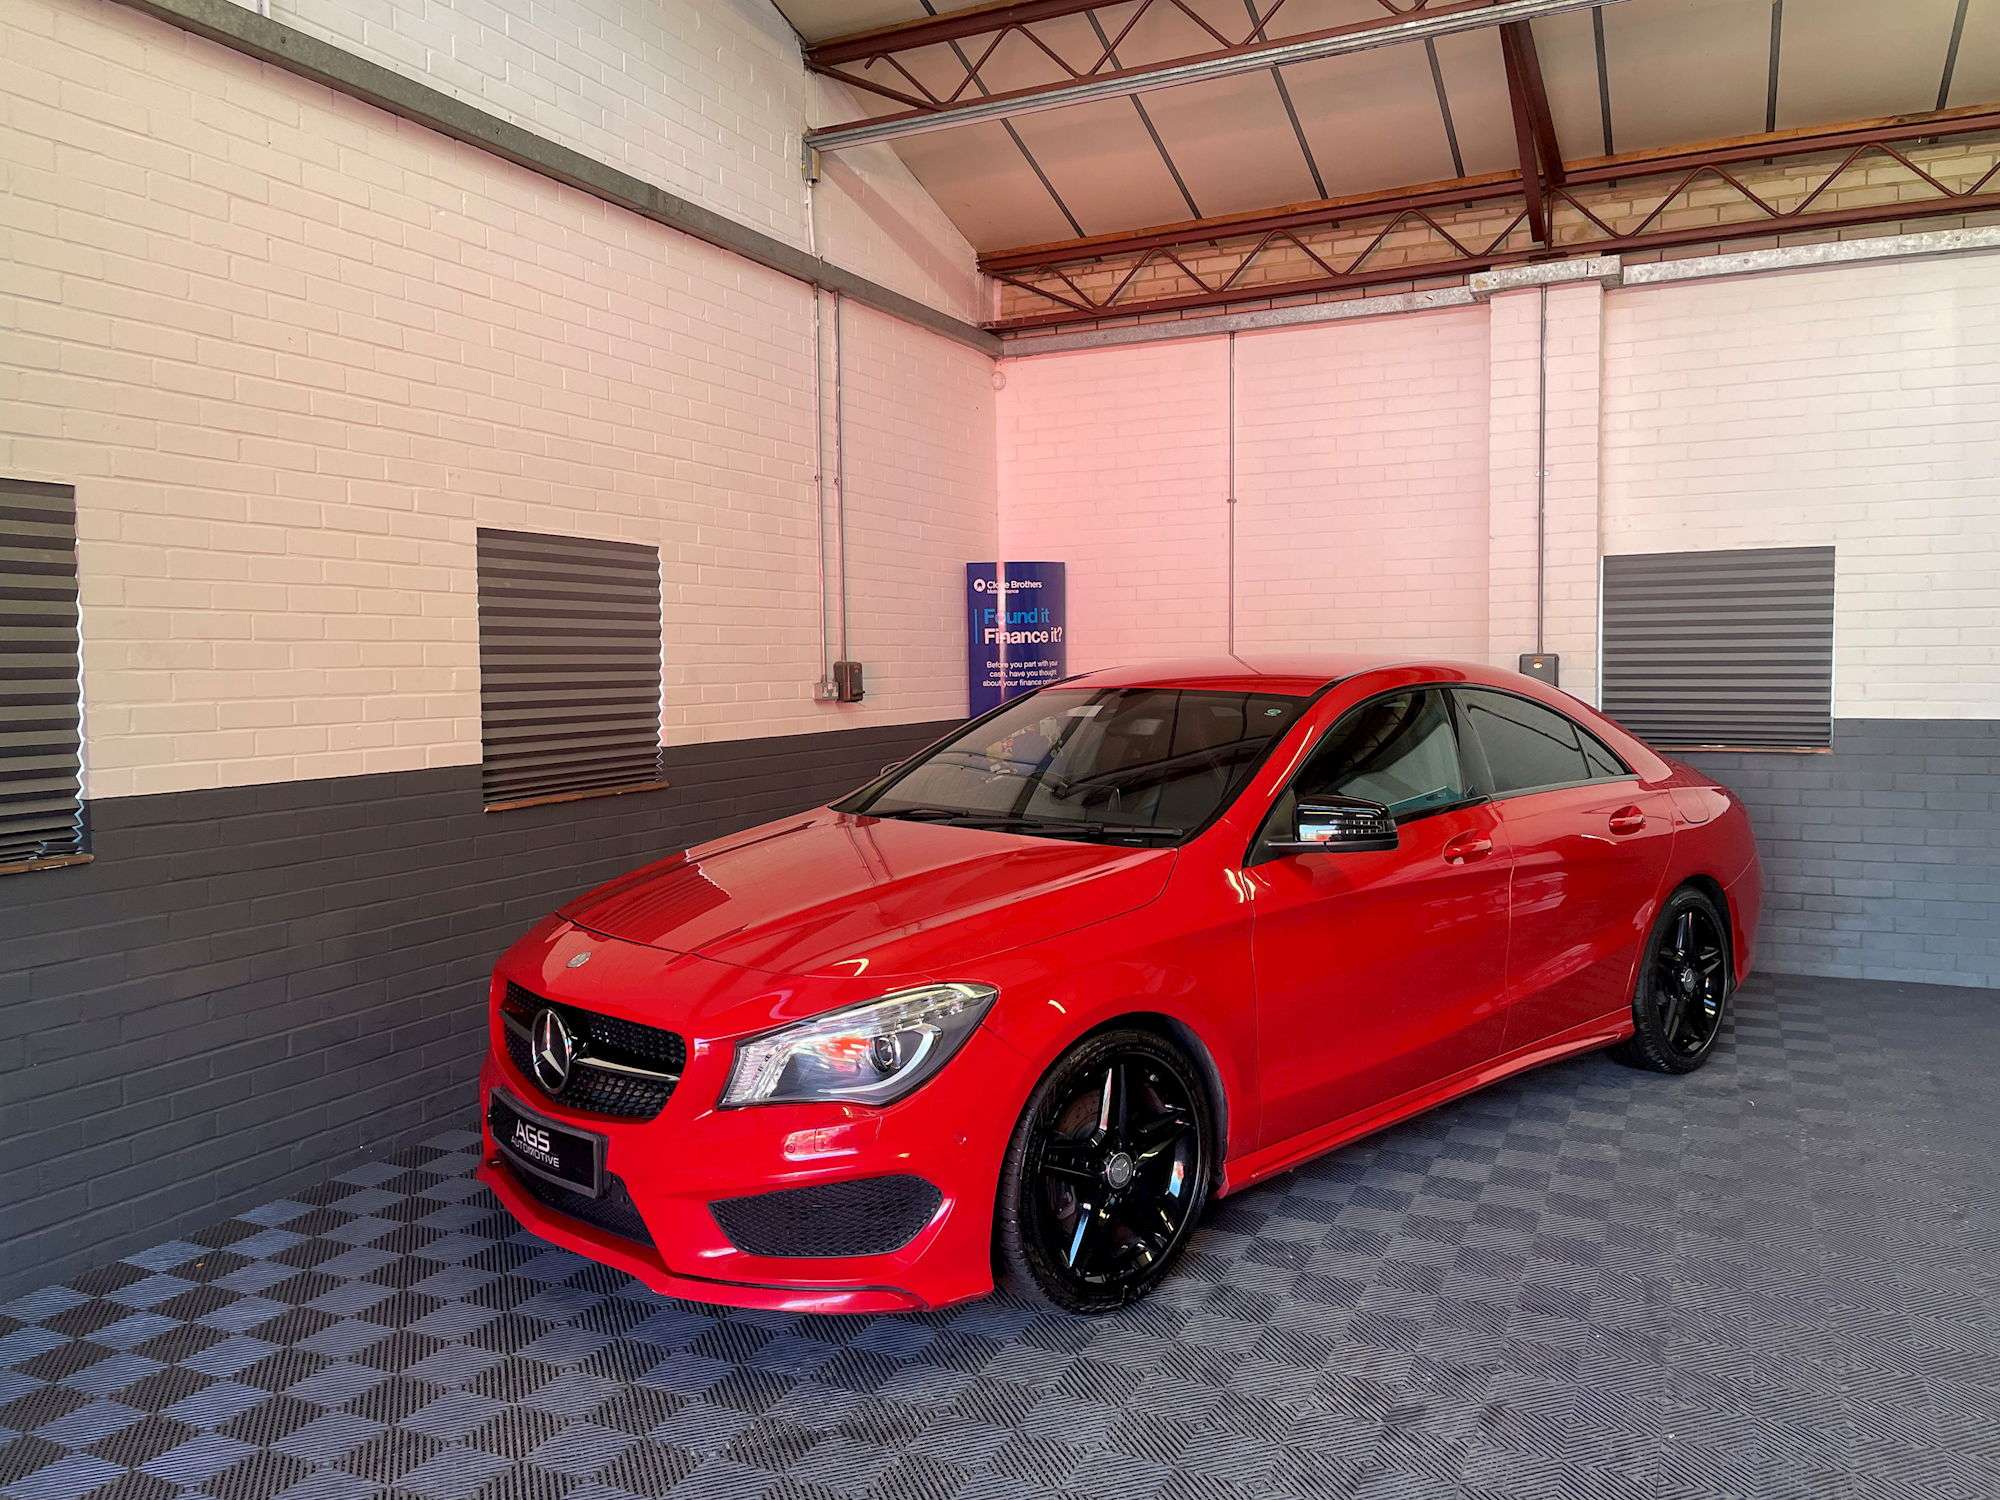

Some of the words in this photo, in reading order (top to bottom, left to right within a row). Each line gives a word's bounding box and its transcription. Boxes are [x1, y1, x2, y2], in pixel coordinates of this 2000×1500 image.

[987, 580, 1010, 589] Cloe
[1011, 580, 1043, 589] Brothers
[1041, 608, 1050, 624] it
[984, 627, 1049, 645] Finance
[1050, 626, 1063, 643] it?
[986, 661, 1009, 669] Before
[1010, 662, 1023, 670] you
[1024, 661, 1037, 669] part
[1009, 670, 1026, 678] have
[1026, 671, 1039, 679] you
[982, 679, 1001, 687] about
[1001, 680, 1018, 689] your
[1019, 679, 1042, 687] finance
[516, 1119, 550, 1153] AGS
[511, 1135, 560, 1168] AUTOMOTIVE
